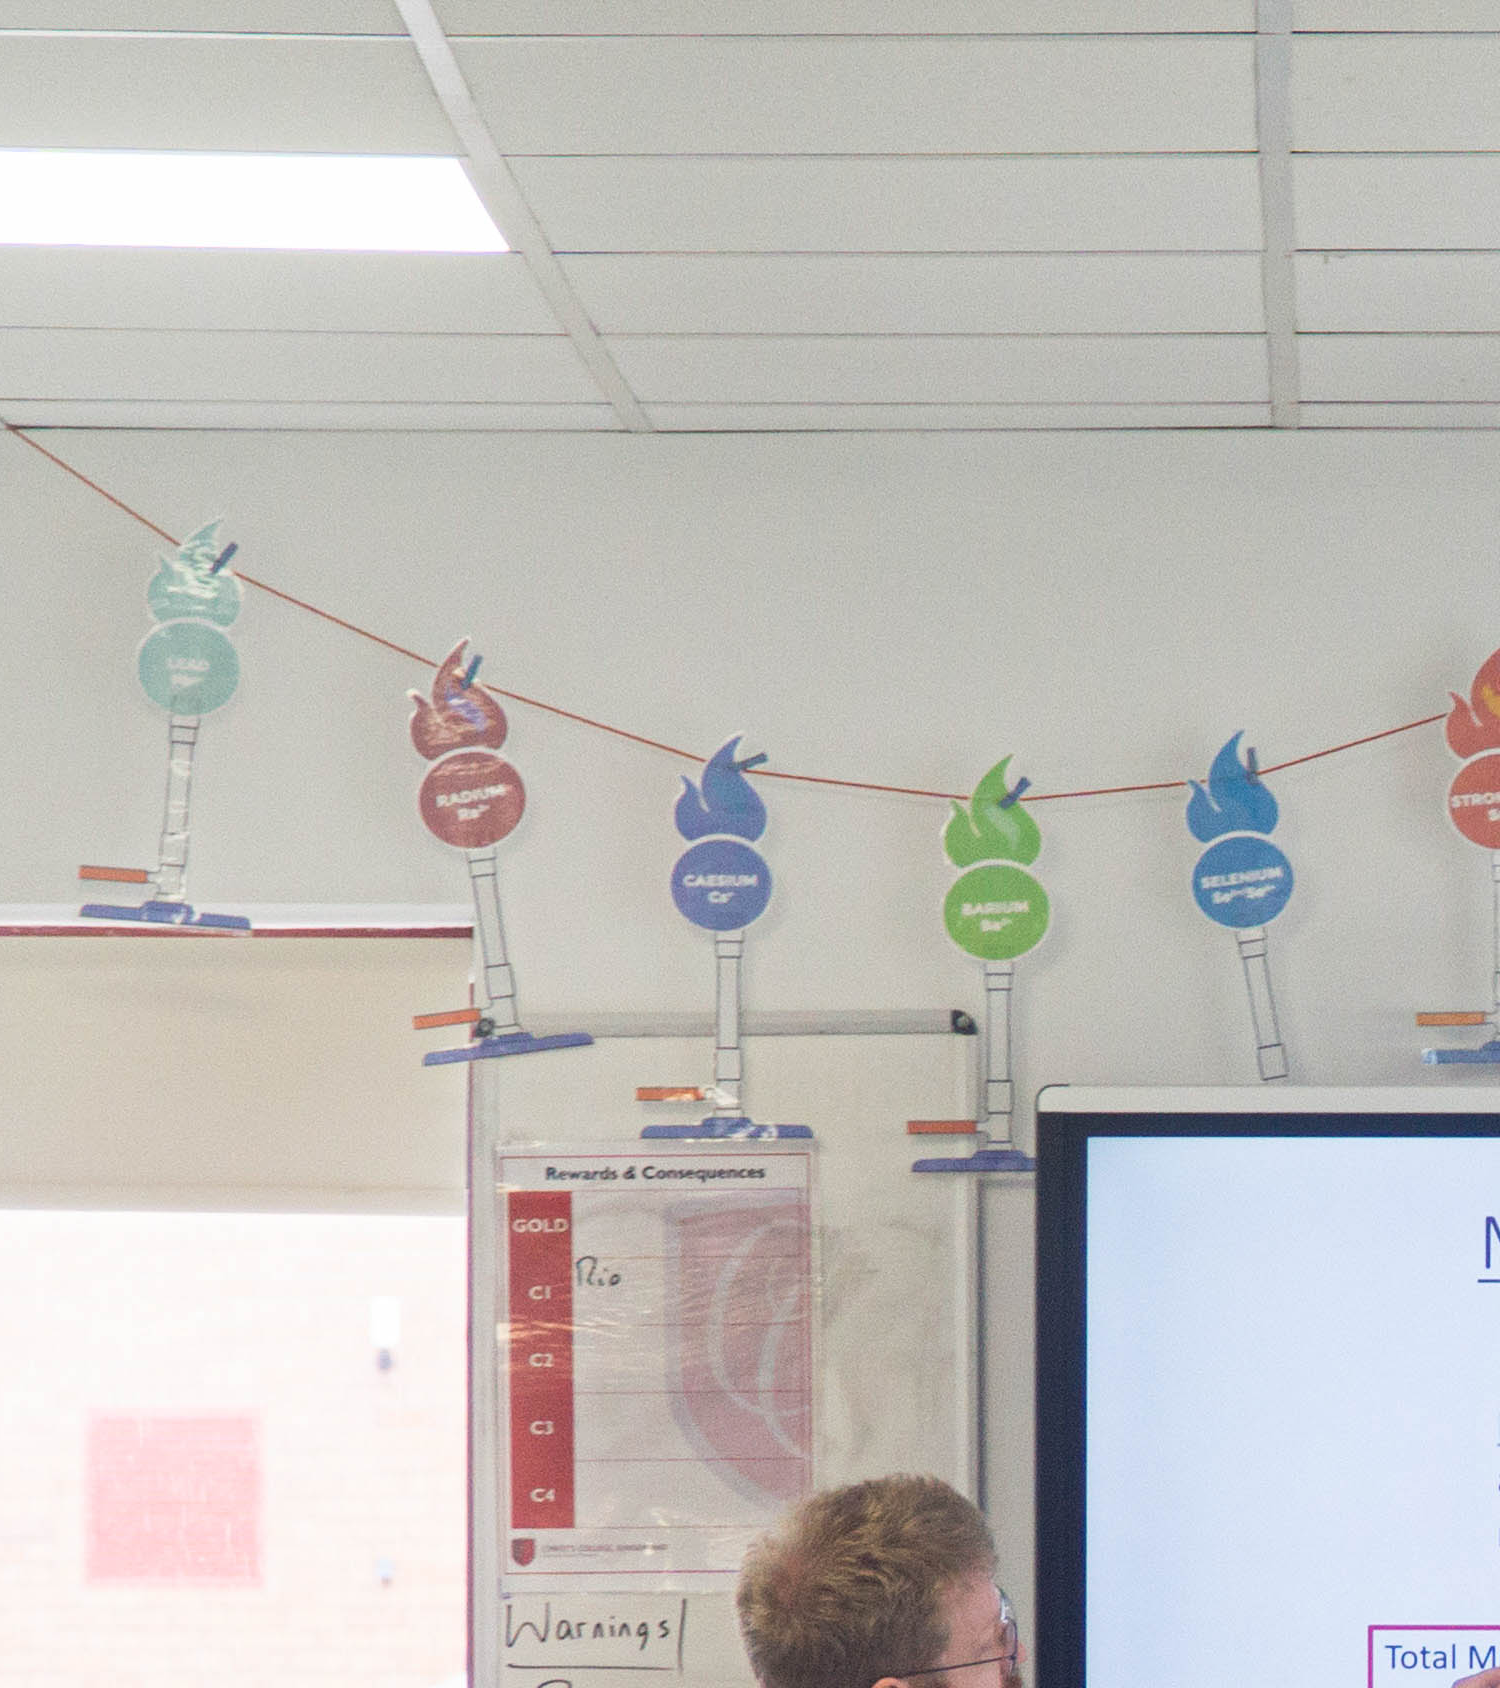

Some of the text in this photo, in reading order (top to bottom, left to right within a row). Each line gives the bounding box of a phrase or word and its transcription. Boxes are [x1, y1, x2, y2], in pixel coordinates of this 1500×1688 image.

[436, 784, 512, 807] RADIUM
[683, 875, 758, 887] CAESIUM
[546, 1165, 765, 1182] Rewards & Consequences
[512, 1218, 569, 1233] GOLD
[575, 1256, 622, 1288] Rio
[529, 1285, 552, 1301] C1
[529, 1353, 554, 1368] C2
[530, 1421, 554, 1436] C3
[530, 1488, 555, 1503] C4
[504, 1601, 670, 1650] Warnings
[1384, 1643, 1457, 1670] Total
